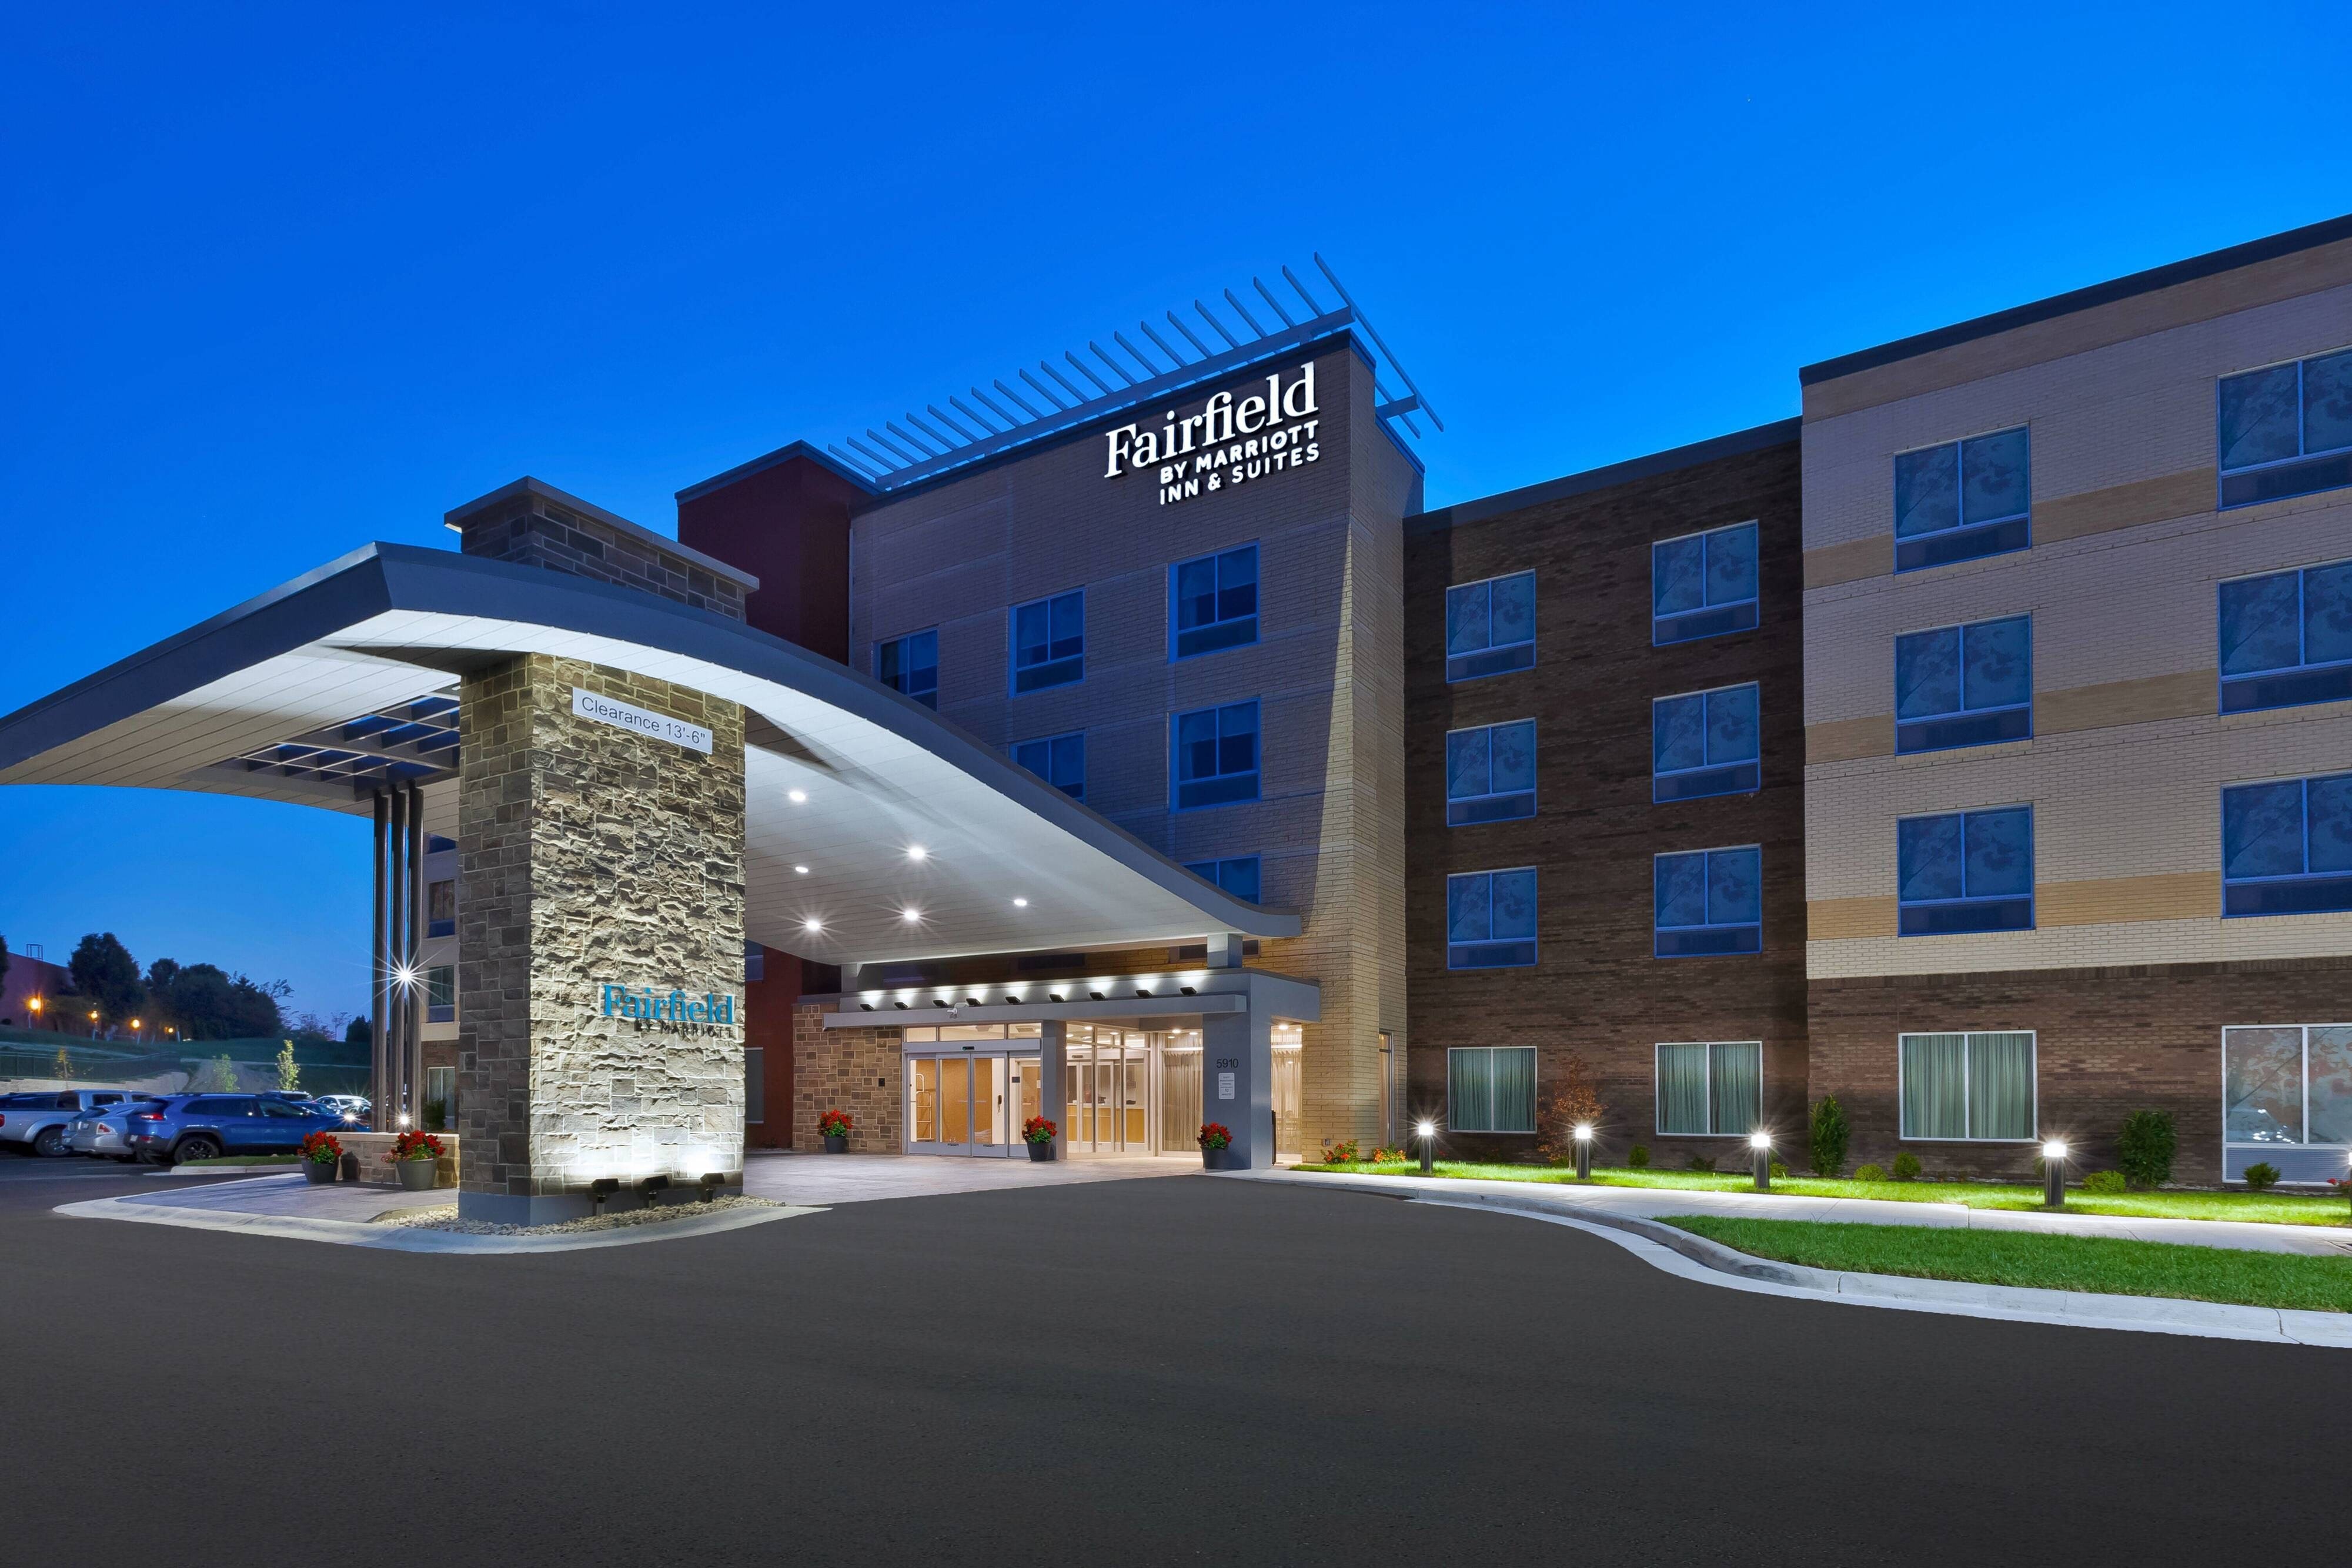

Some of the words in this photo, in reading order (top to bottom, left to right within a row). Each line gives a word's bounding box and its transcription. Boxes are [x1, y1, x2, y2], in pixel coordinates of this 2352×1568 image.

[1104, 361, 1318, 478] Fairfield
[1160, 461, 1187, 484] BY
[1196, 420, 1319, 473] MARRIOTT
[1160, 479, 1198, 505] INN
[1208, 473, 1221, 491] &
[1232, 443, 1319, 483] SUITES
[582, 697, 660, 731] Clearance
[666, 723, 706, 744] 13'-6"
[600, 984, 734, 1024] Fairfield
[660, 1020, 733, 1038] MARRIOTT
[1217, 1058, 1238, 1068] 5910
